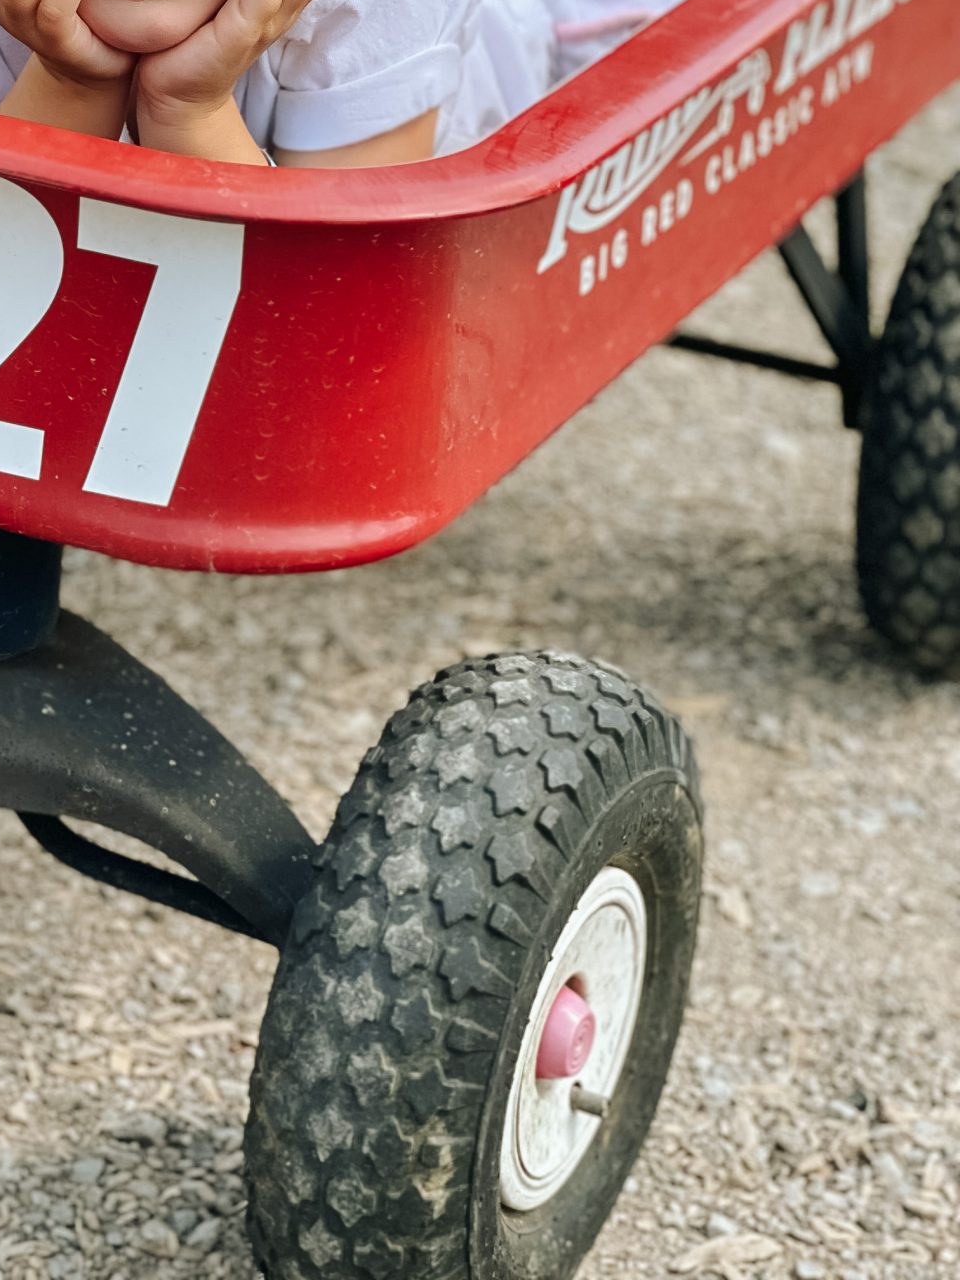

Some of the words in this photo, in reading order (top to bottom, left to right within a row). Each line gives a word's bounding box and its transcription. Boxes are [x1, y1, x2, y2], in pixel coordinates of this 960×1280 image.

[578, 228, 628, 296] BIG
[641, 178, 693, 246] RED
[705, 85, 814, 194] CLASSIC
